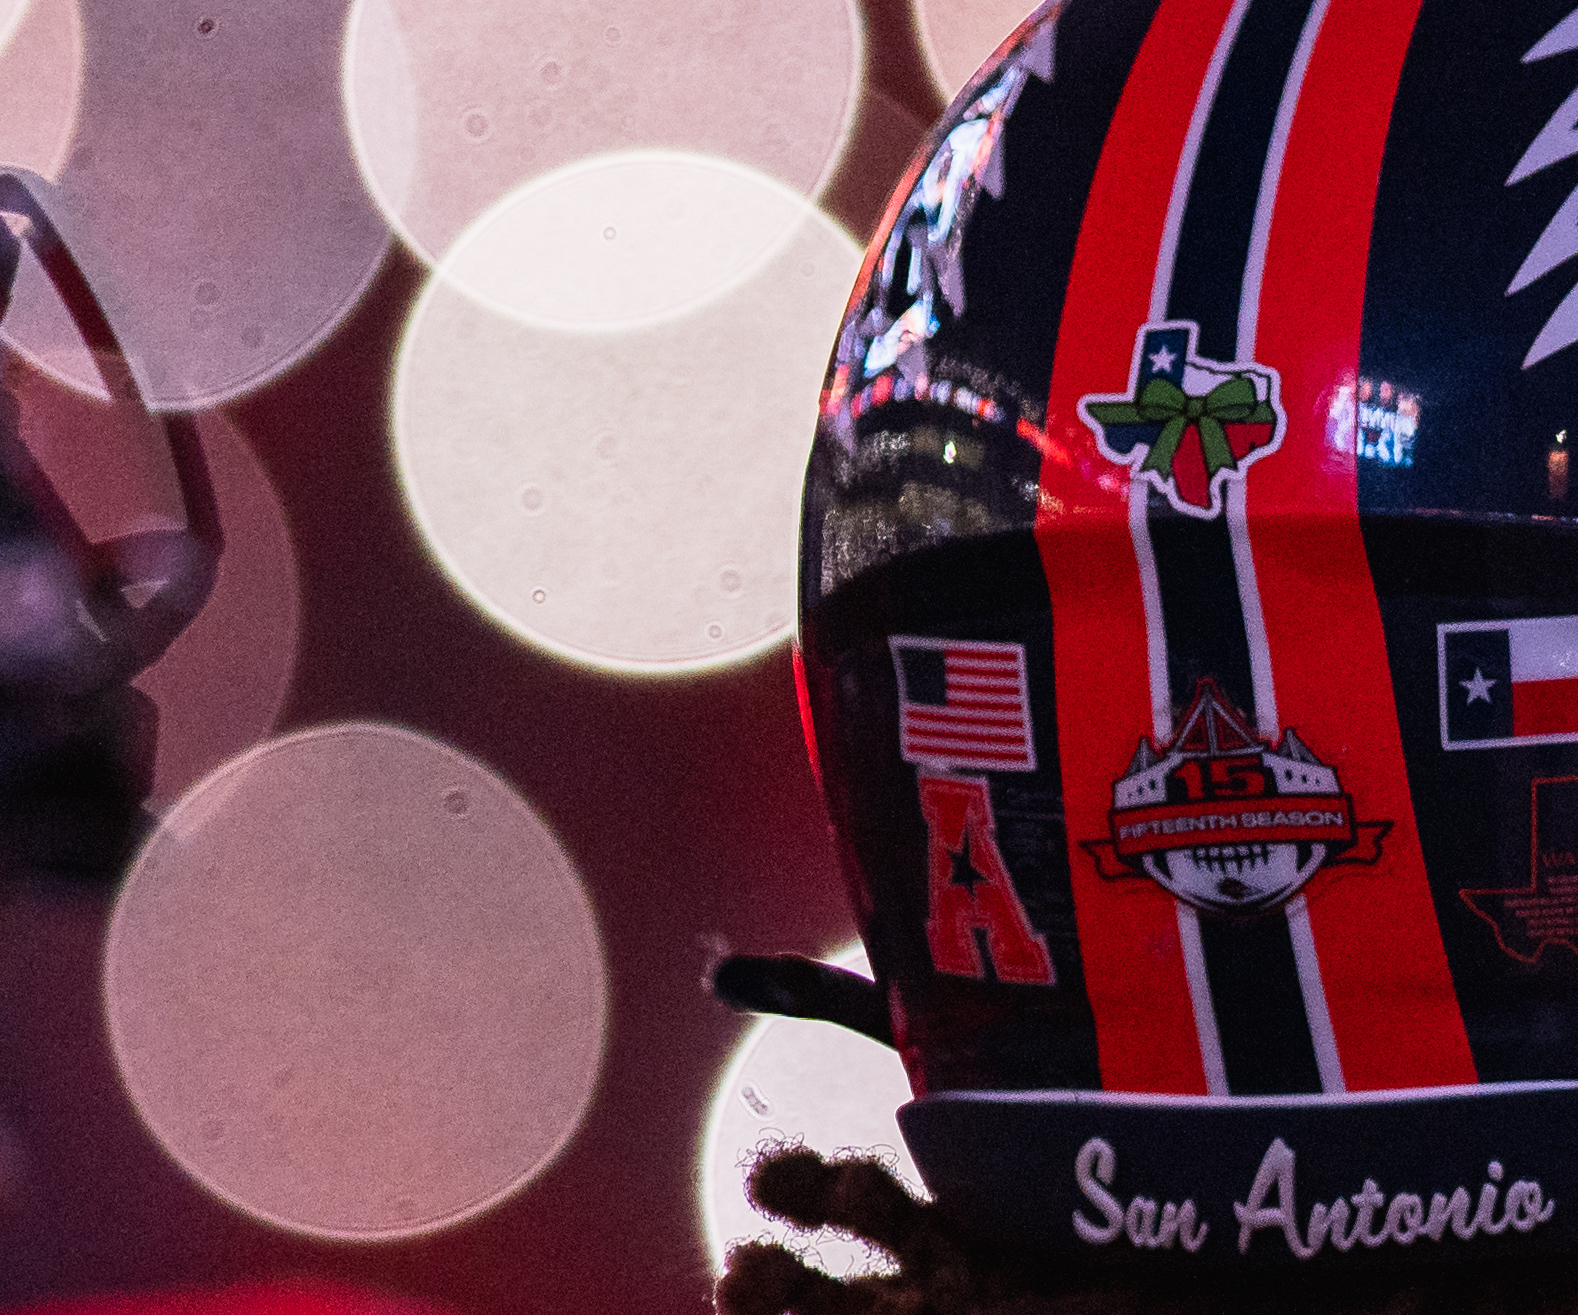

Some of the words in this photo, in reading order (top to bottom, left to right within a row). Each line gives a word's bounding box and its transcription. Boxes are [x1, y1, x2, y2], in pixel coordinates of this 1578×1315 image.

[1173, 756, 1266, 800] 15
[1119, 812, 1238, 840] FIFTEENTH
[1240, 810, 1344, 828] SEASON
[1072, 1136, 1208, 1254] San
[1233, 1136, 1556, 1261] Antonio
